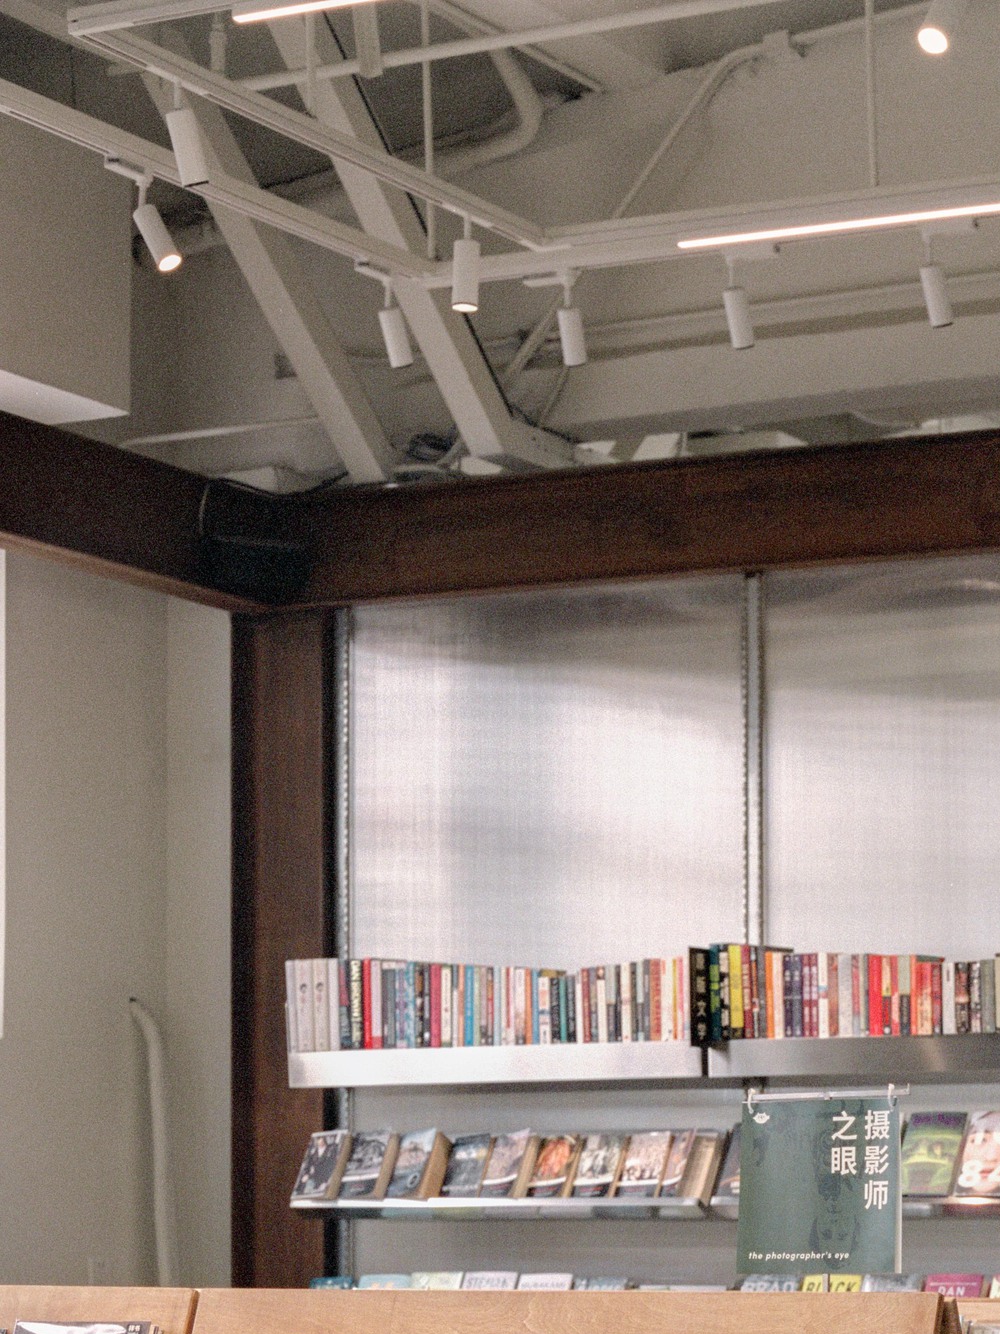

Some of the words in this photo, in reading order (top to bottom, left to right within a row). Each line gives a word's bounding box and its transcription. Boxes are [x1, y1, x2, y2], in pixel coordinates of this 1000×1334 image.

[830, 1111, 857, 1176] 之眼
[864, 1110, 890, 1210] 摄影师
[748, 1251, 763, 1260] the
[765, 1251, 833, 1262] photographer's
[834, 1252, 850, 1261] eye
